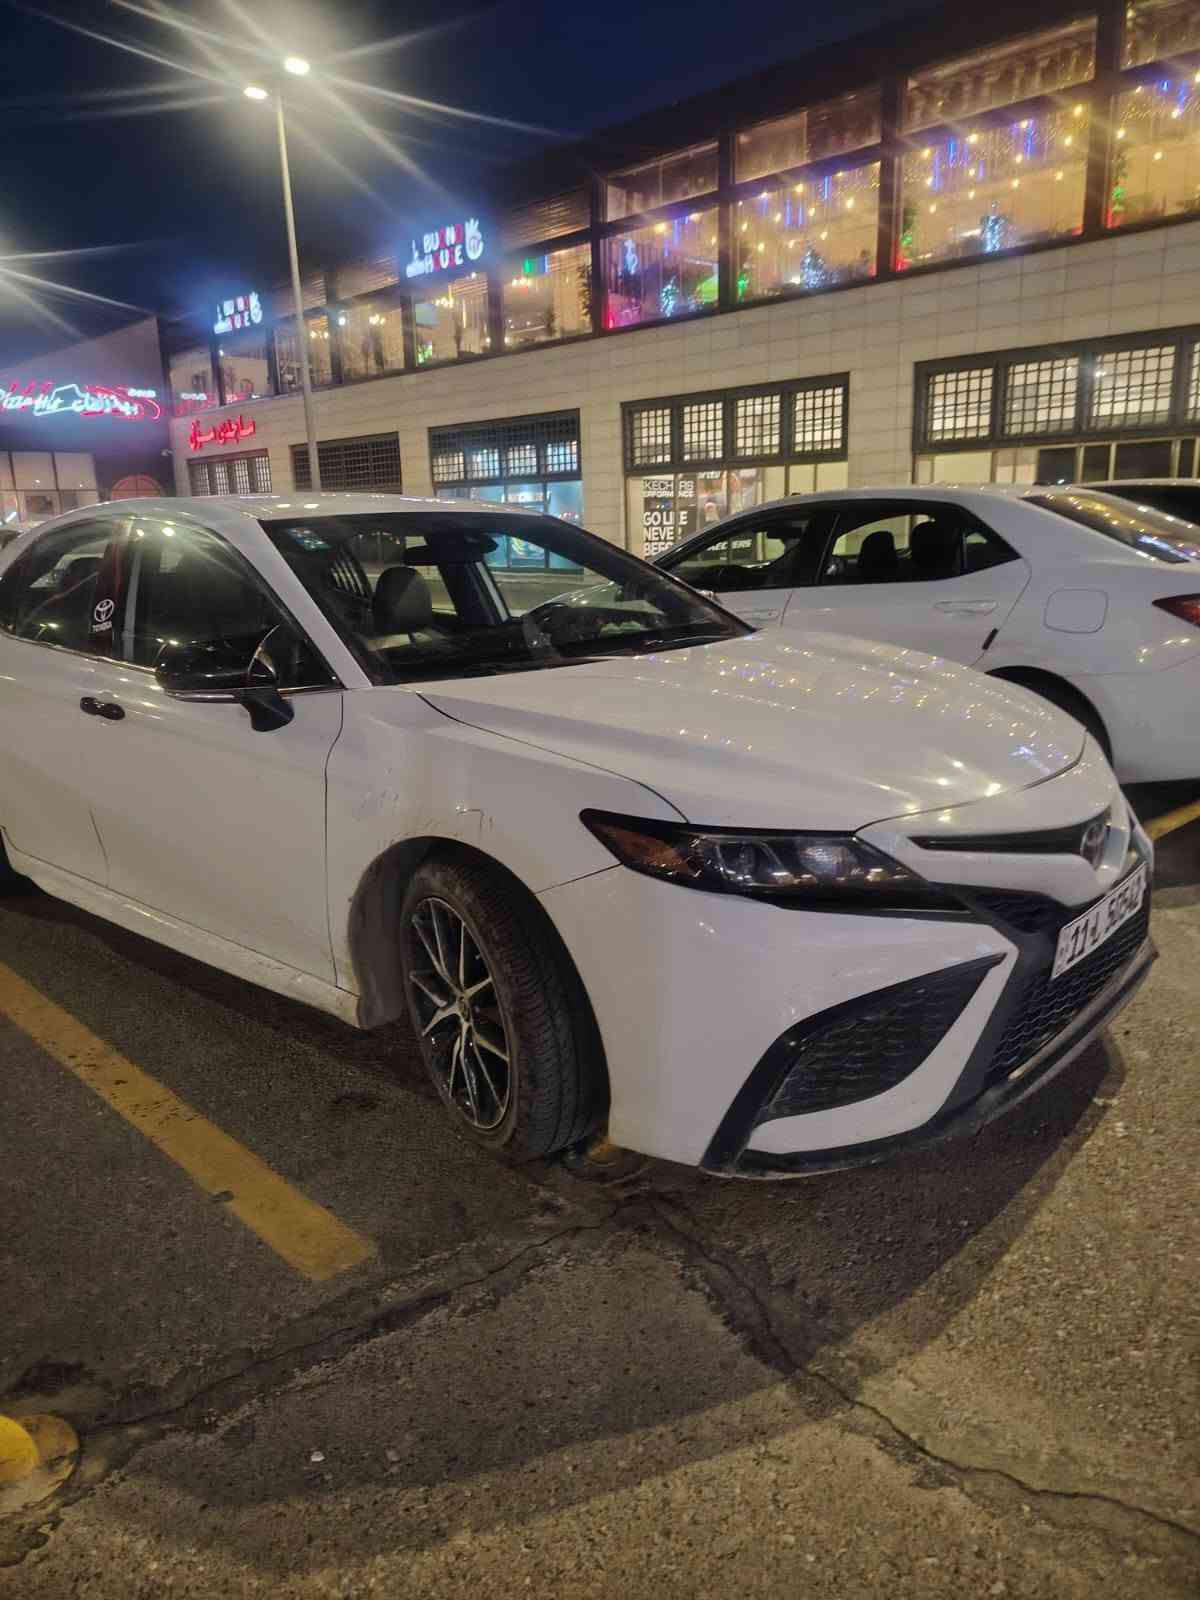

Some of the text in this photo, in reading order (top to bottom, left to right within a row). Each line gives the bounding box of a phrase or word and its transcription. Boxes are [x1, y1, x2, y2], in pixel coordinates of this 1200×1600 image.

[640, 480, 695, 491] KECHRS
[642, 510, 689, 526] GO LIE
[1066, 917, 1089, 964] 11
